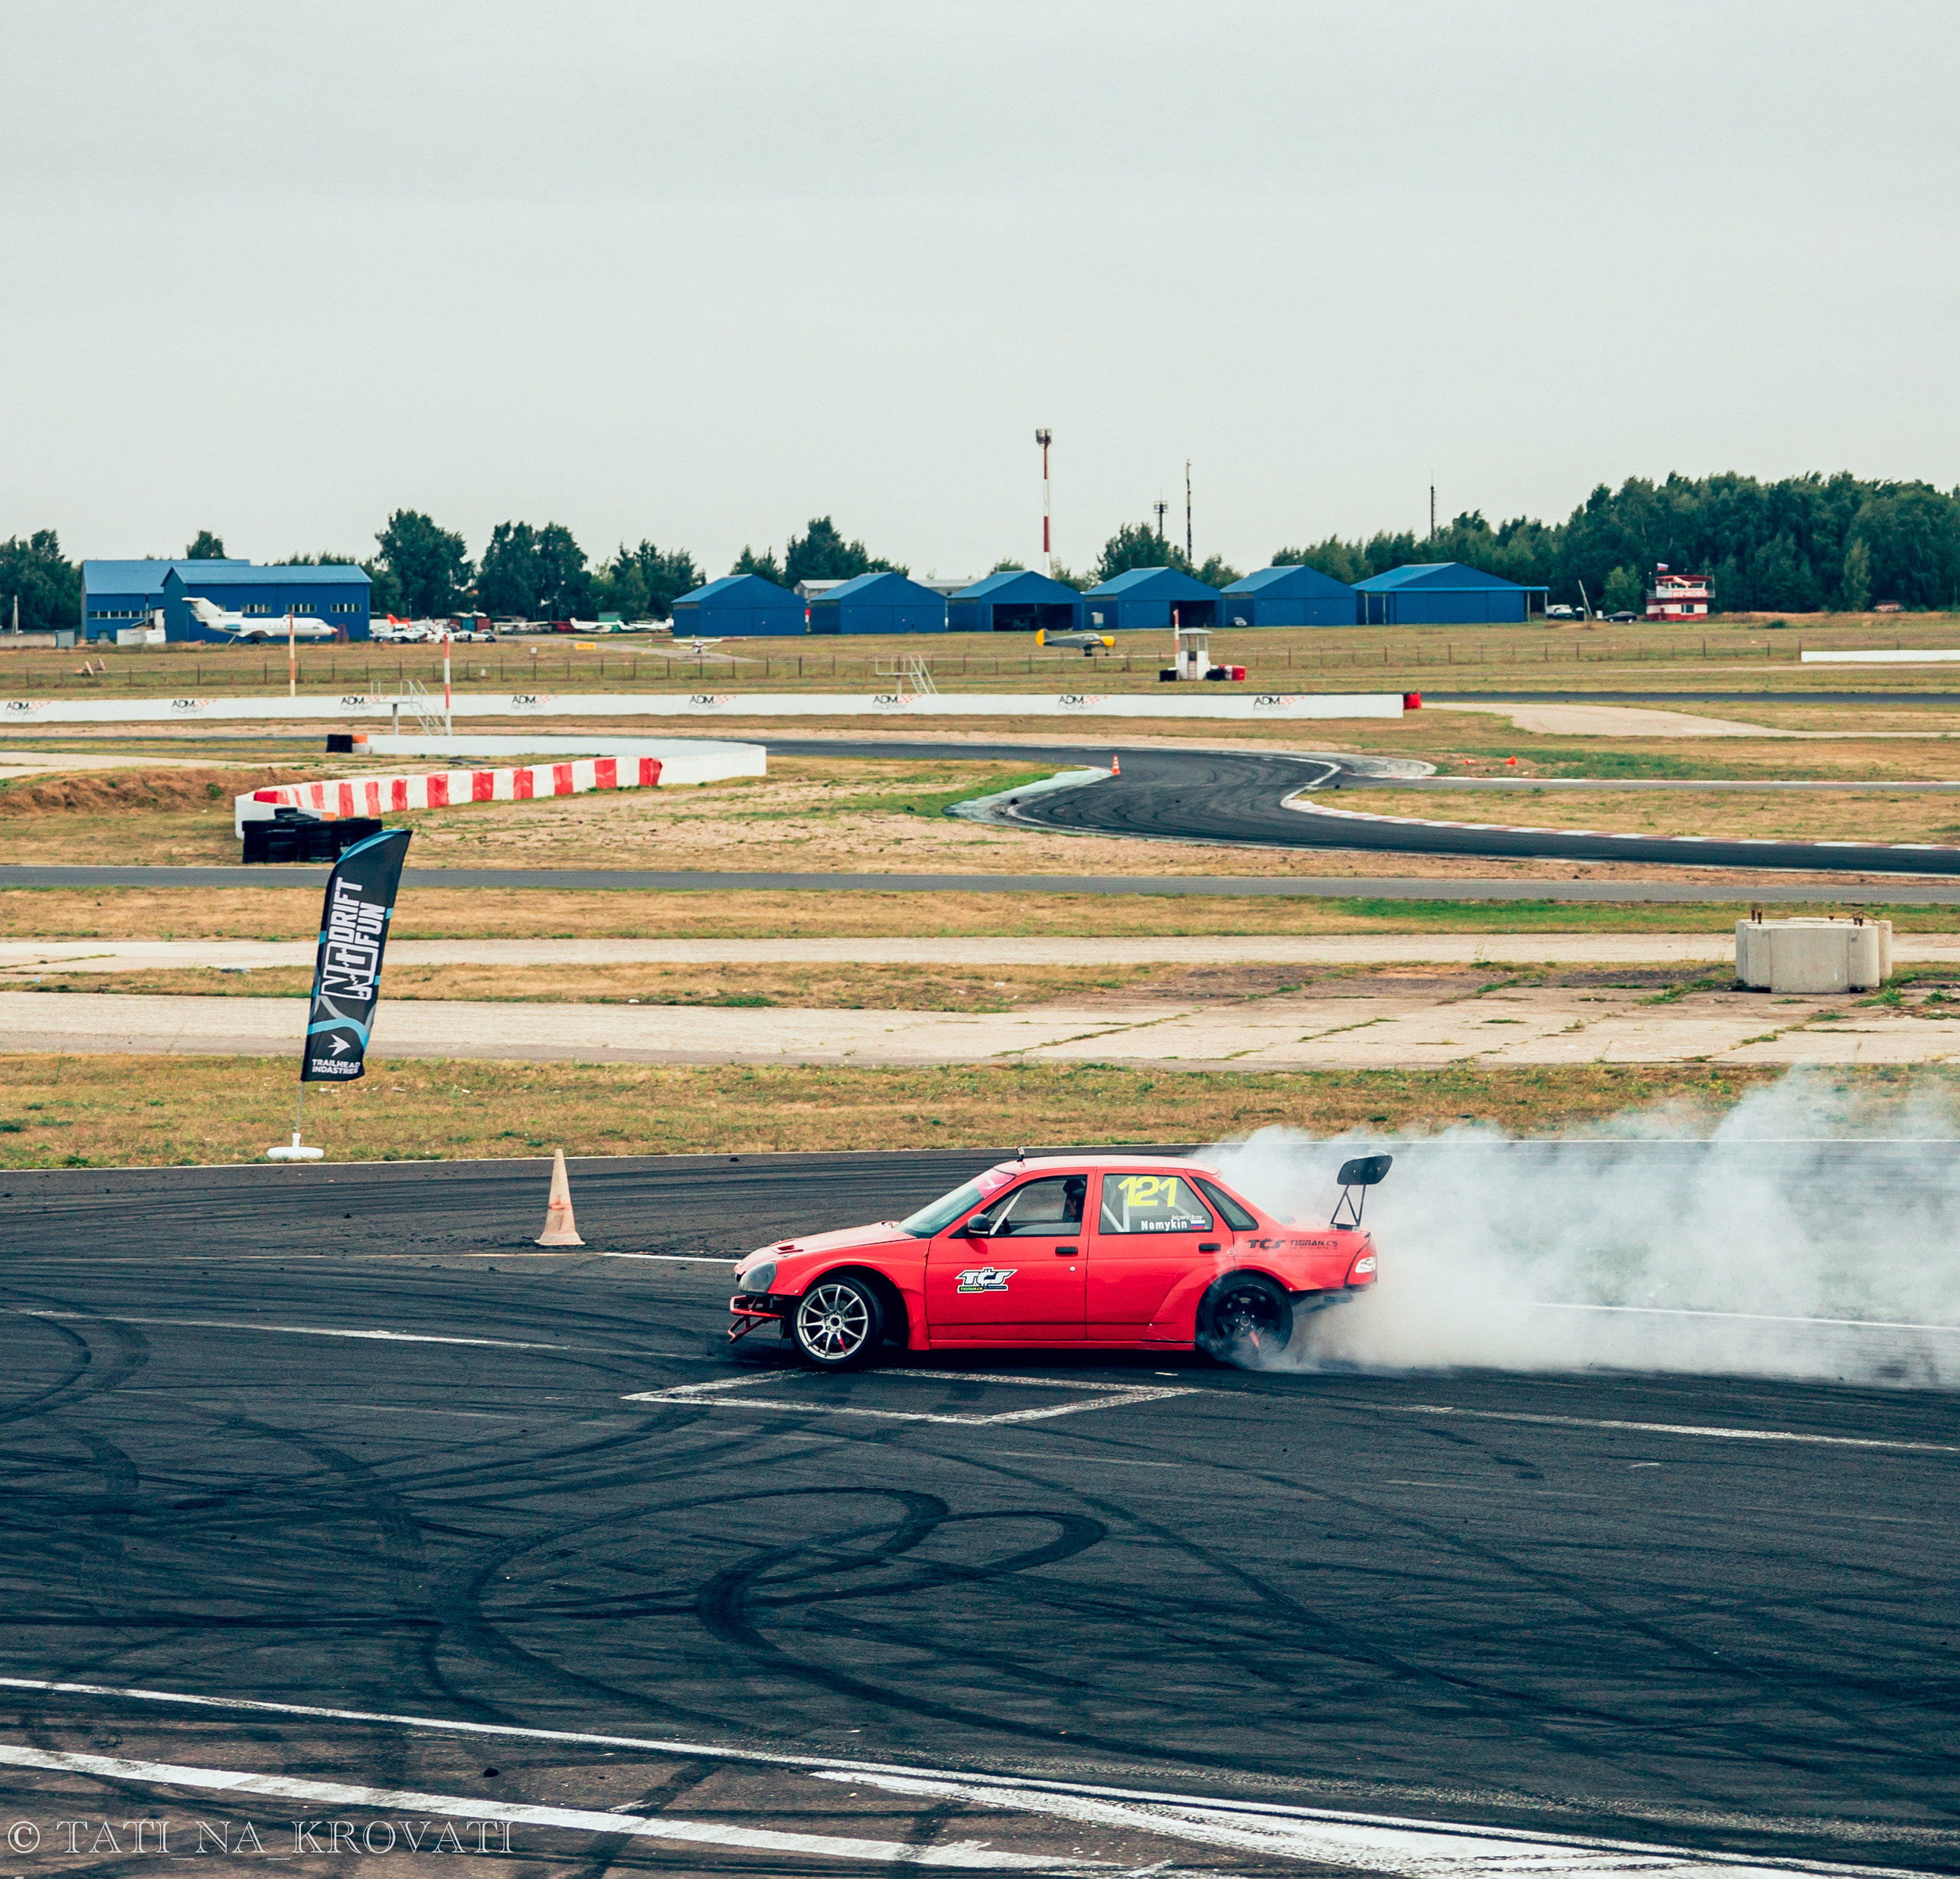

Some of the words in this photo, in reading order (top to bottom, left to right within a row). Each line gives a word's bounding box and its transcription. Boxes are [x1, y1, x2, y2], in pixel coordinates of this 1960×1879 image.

[172, 699, 195, 707] ADM
[512, 695, 536, 704] ADM
[690, 695, 714, 704] ADM
[873, 694, 898, 704] ADM
[1058, 695, 1084, 704] ADM
[1254, 696, 1280, 705] ADM
[6, 701, 29, 710] ADM
[328, 877, 363, 944] DRIFT
[354, 902, 386, 948] FUN
[1118, 1176, 1178, 1207] 121
[1140, 1218, 1187, 1231] Nemykin
